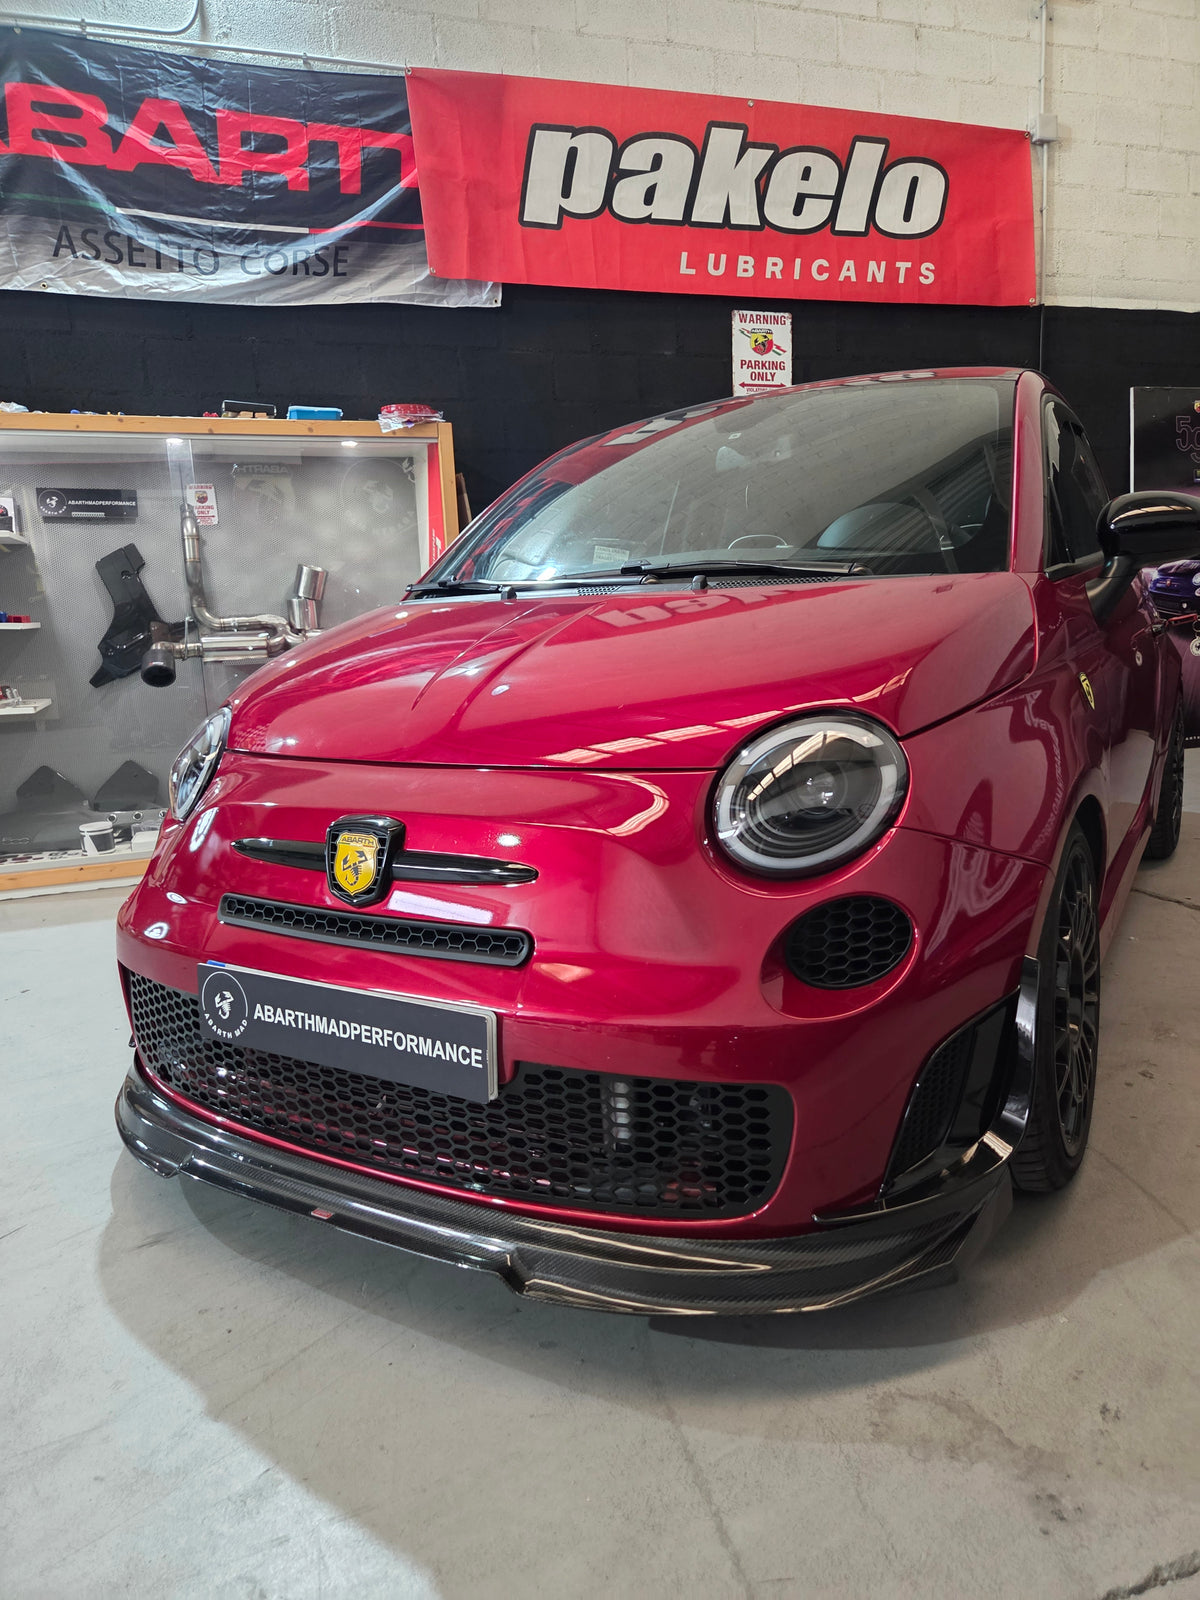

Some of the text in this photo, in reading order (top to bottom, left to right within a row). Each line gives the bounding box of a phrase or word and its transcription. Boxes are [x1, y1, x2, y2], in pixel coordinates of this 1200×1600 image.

[519, 121, 949, 239] pakelo
[53, 225, 349, 277] ASSETTO CORSE
[680, 252, 937, 285] LUBRICANTS
[739, 313, 786, 325] WARNING
[740, 360, 786, 371] PARKING
[750, 371, 776, 382] ONLY
[341, 836, 374, 846] ABARTH
[204, 1013, 248, 1039] ABARTH MAD
[253, 1002, 483, 1070] ABARTHMADPERFORMANCE
